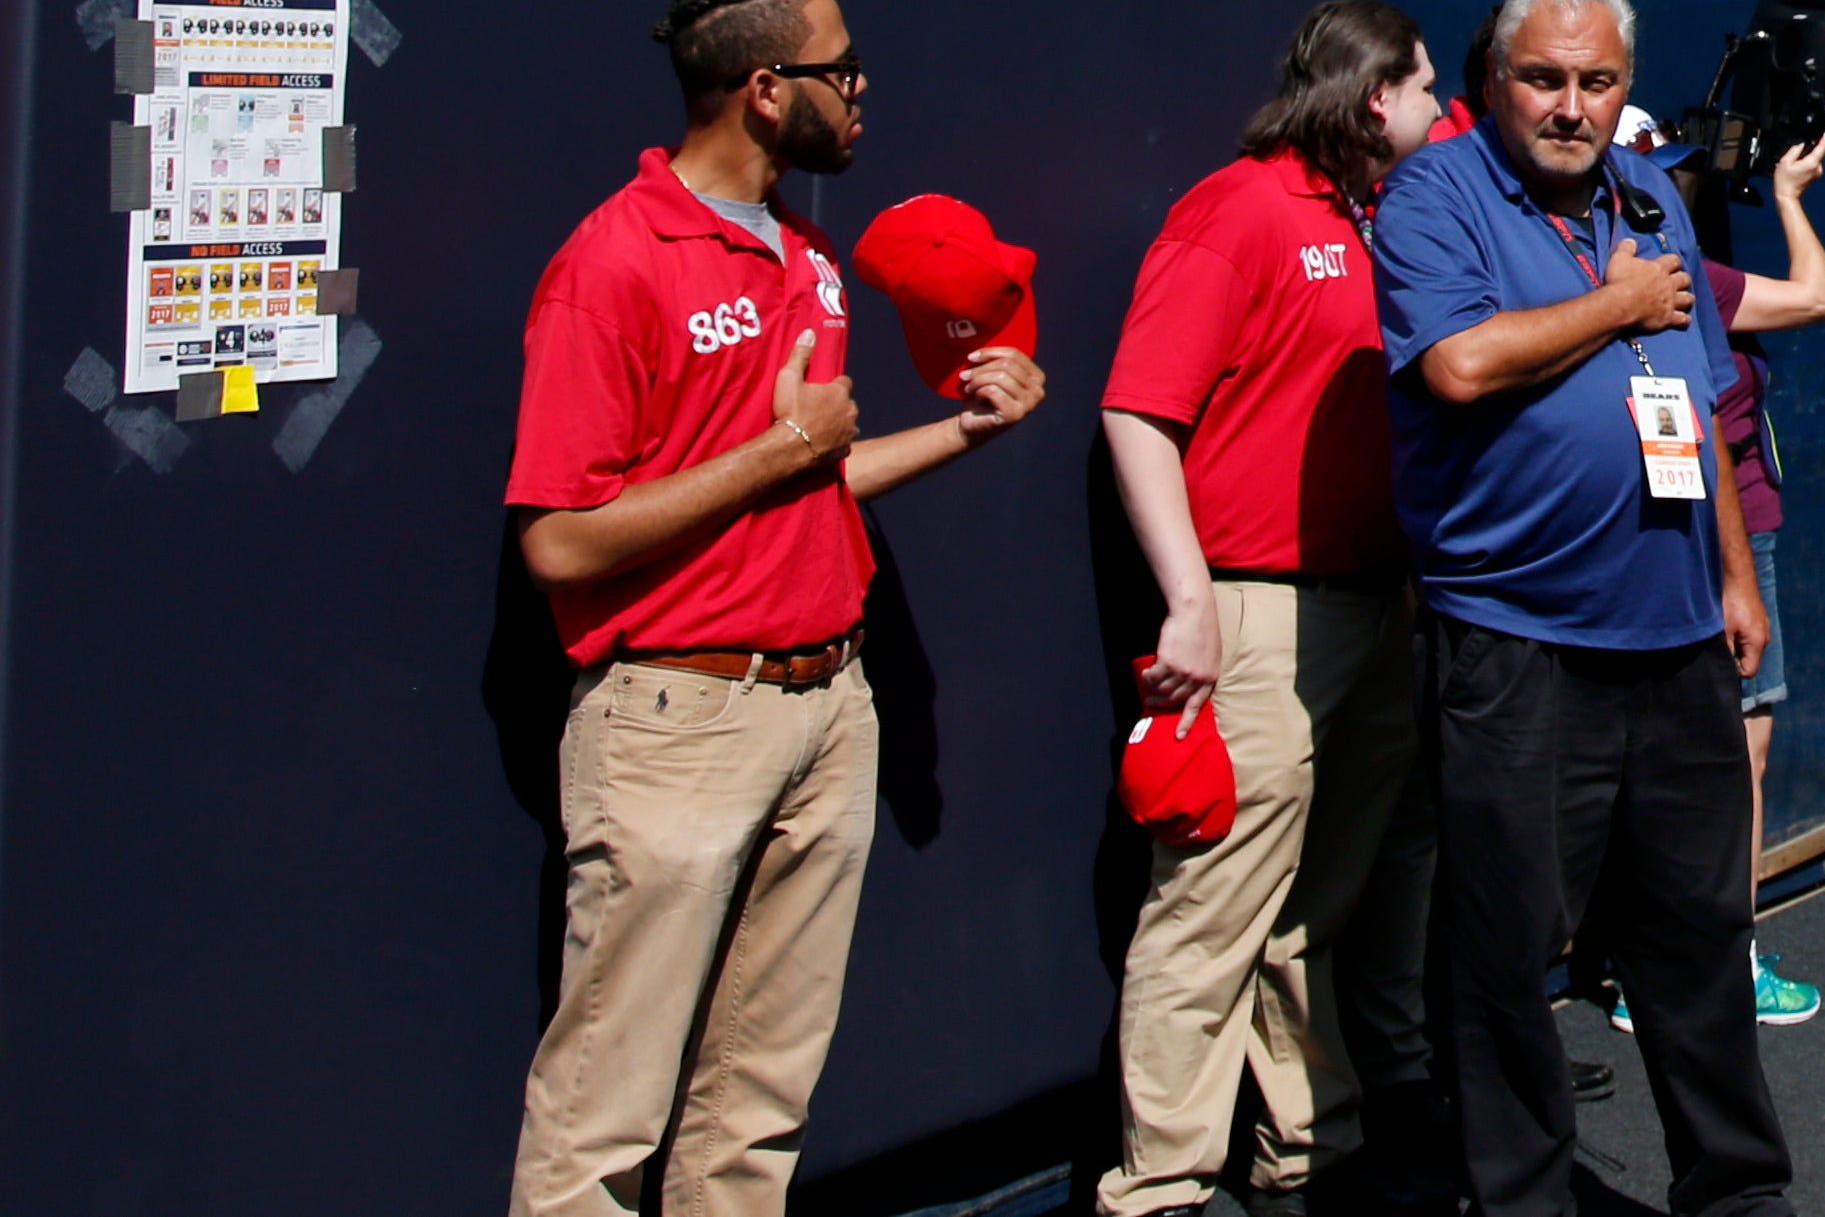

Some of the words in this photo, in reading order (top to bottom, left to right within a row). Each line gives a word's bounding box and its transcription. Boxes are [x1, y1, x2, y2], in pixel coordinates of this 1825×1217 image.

[202, 73, 248, 86] LIMITED
[249, 74, 281, 87] FIELD
[281, 74, 321, 88] ACCESS
[190, 245, 209, 257] NO
[209, 244, 241, 256] FIELD
[241, 242, 284, 255] ACCESS
[687, 295, 762, 345] 863
[1642, 392, 1681, 401] BEARS
[1656, 469, 1695, 487] 2017
